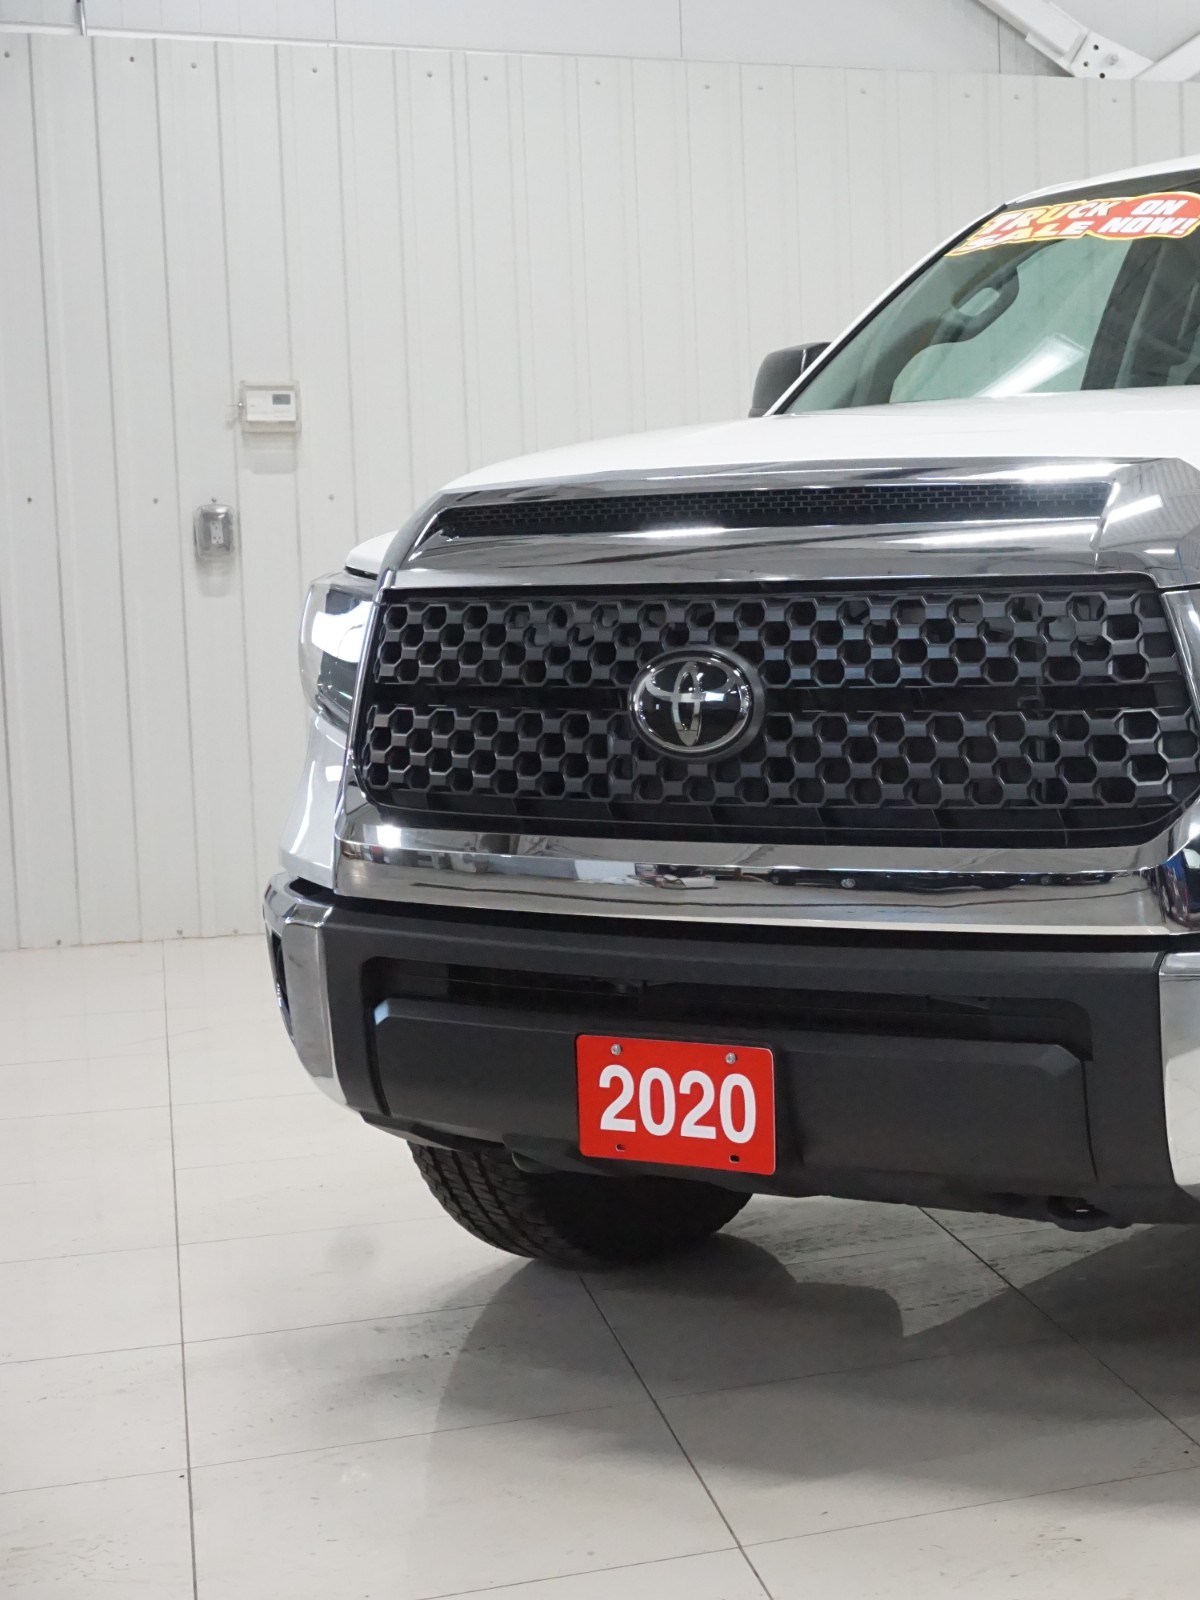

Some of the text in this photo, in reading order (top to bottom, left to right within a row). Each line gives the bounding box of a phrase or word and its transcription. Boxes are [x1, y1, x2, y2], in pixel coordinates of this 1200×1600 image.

[983, 199, 1188, 232] TRUCK ON
[967, 217, 1197, 248] SALE NOW!
[598, 1064, 757, 1144] 2020
